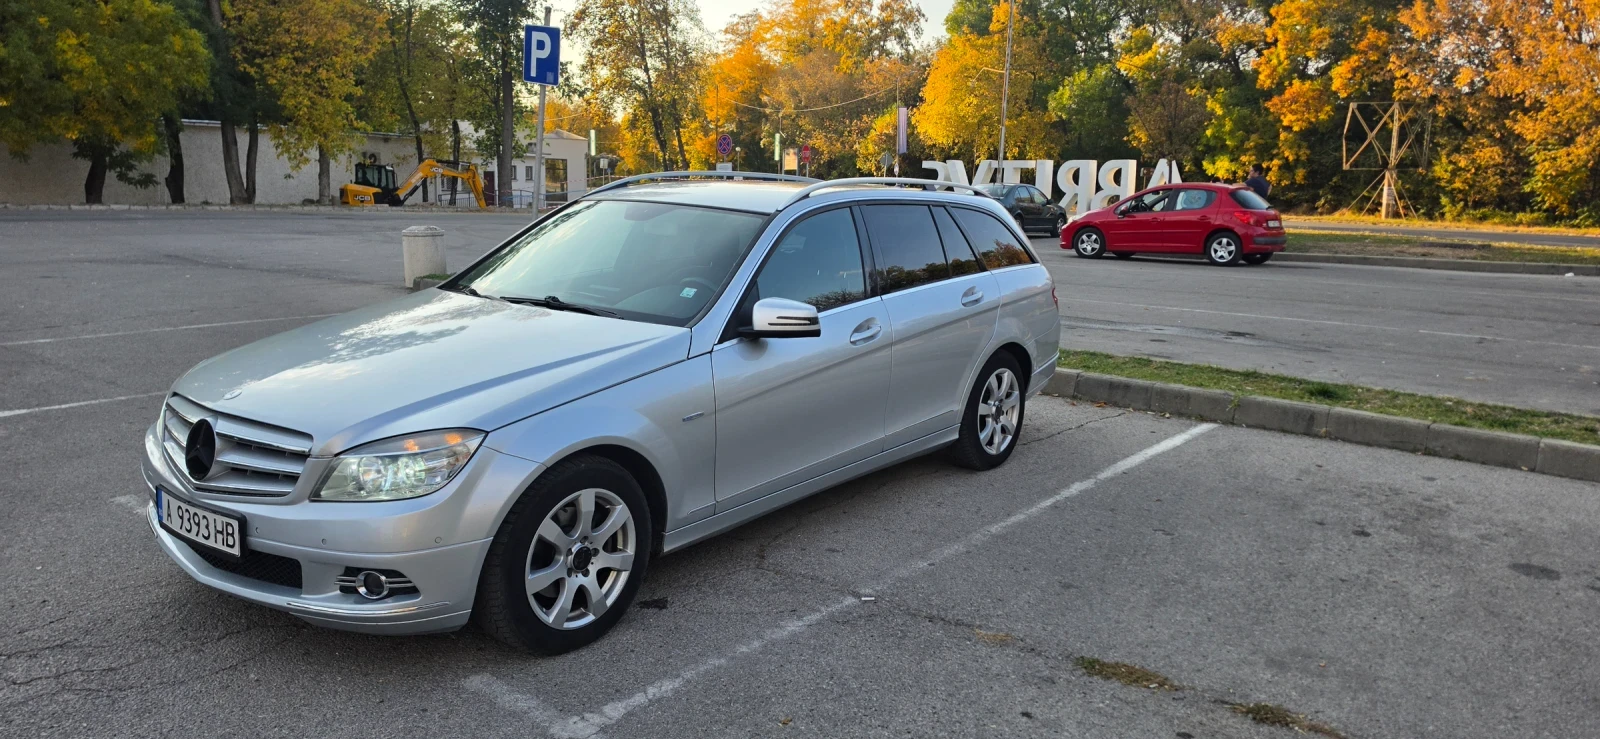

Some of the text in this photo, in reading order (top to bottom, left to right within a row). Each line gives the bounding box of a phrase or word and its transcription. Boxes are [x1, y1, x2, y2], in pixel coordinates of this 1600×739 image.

[531, 31, 551, 77] P
[166, 499, 236, 549] A 9393 HB
